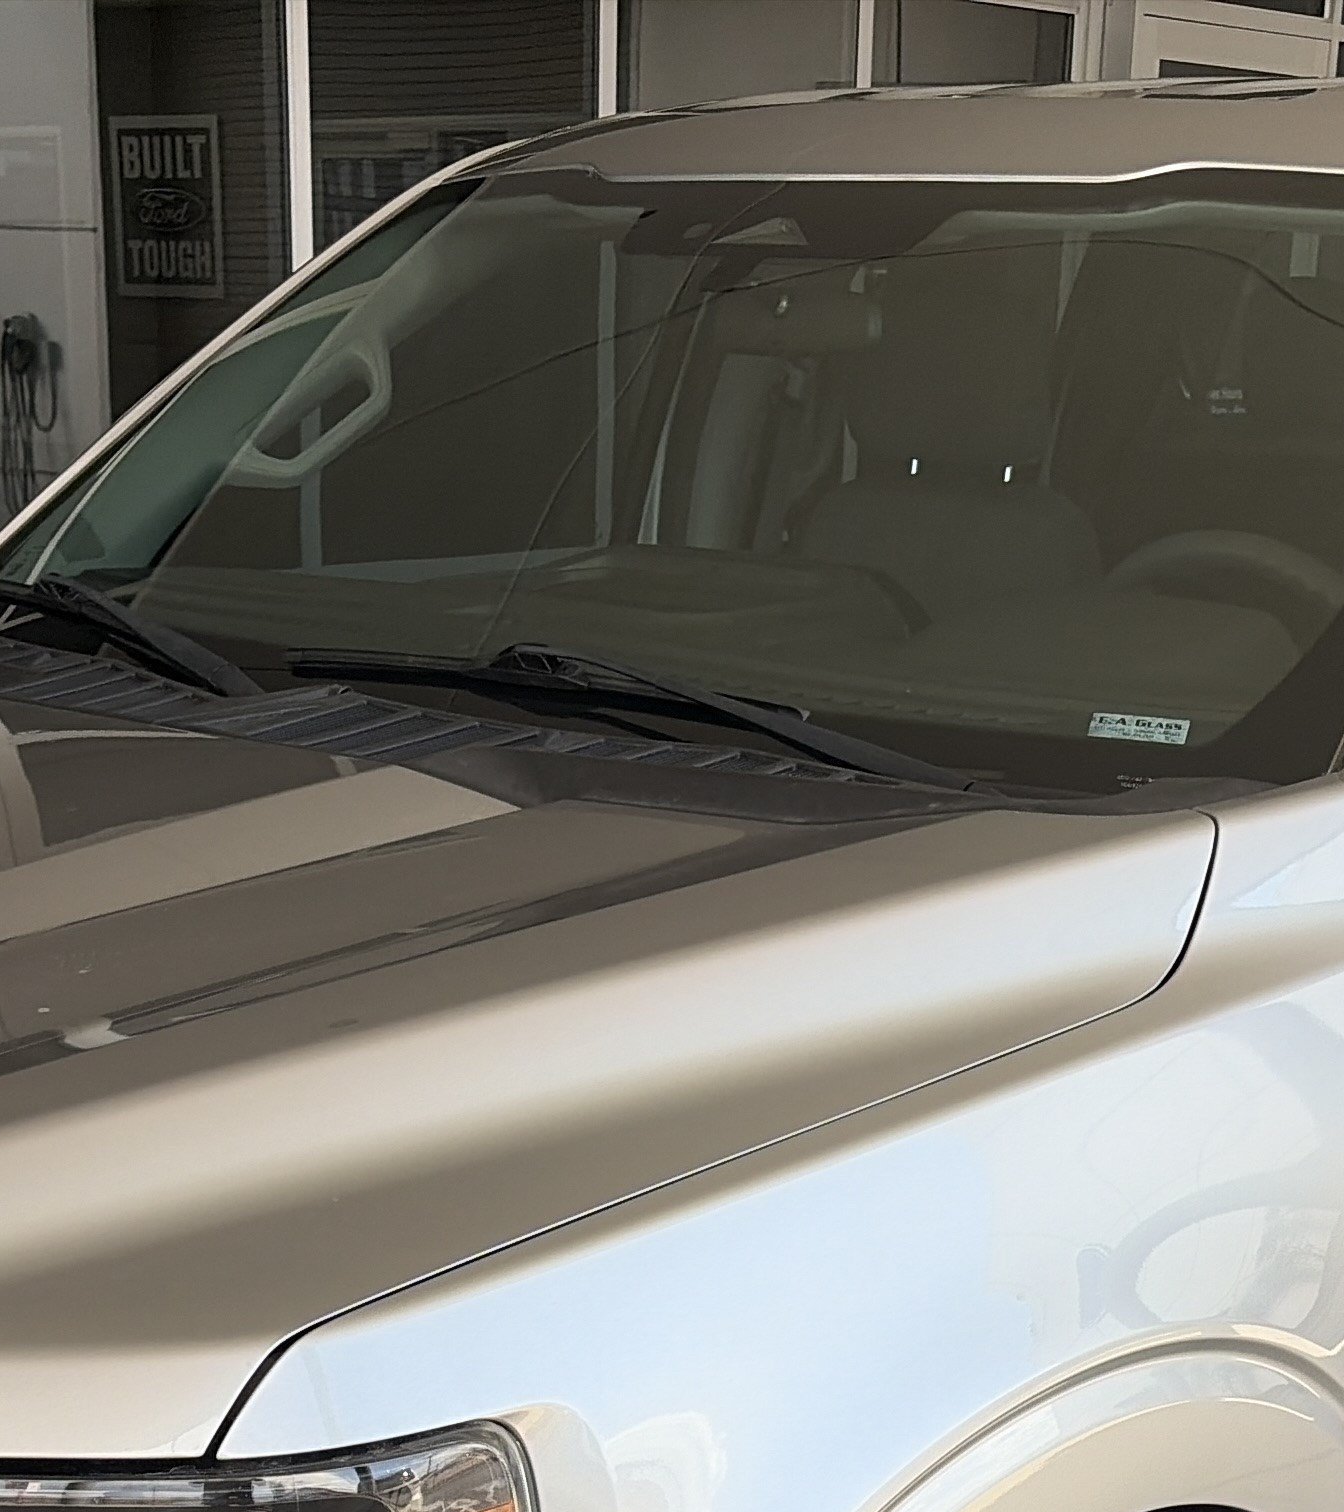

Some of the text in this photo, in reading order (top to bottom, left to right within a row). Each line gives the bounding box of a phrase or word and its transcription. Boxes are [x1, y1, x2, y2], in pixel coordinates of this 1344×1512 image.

[120, 134, 207, 179] BUILT
[138, 192, 192, 224] Ford
[126, 238, 213, 280] TOUGH
